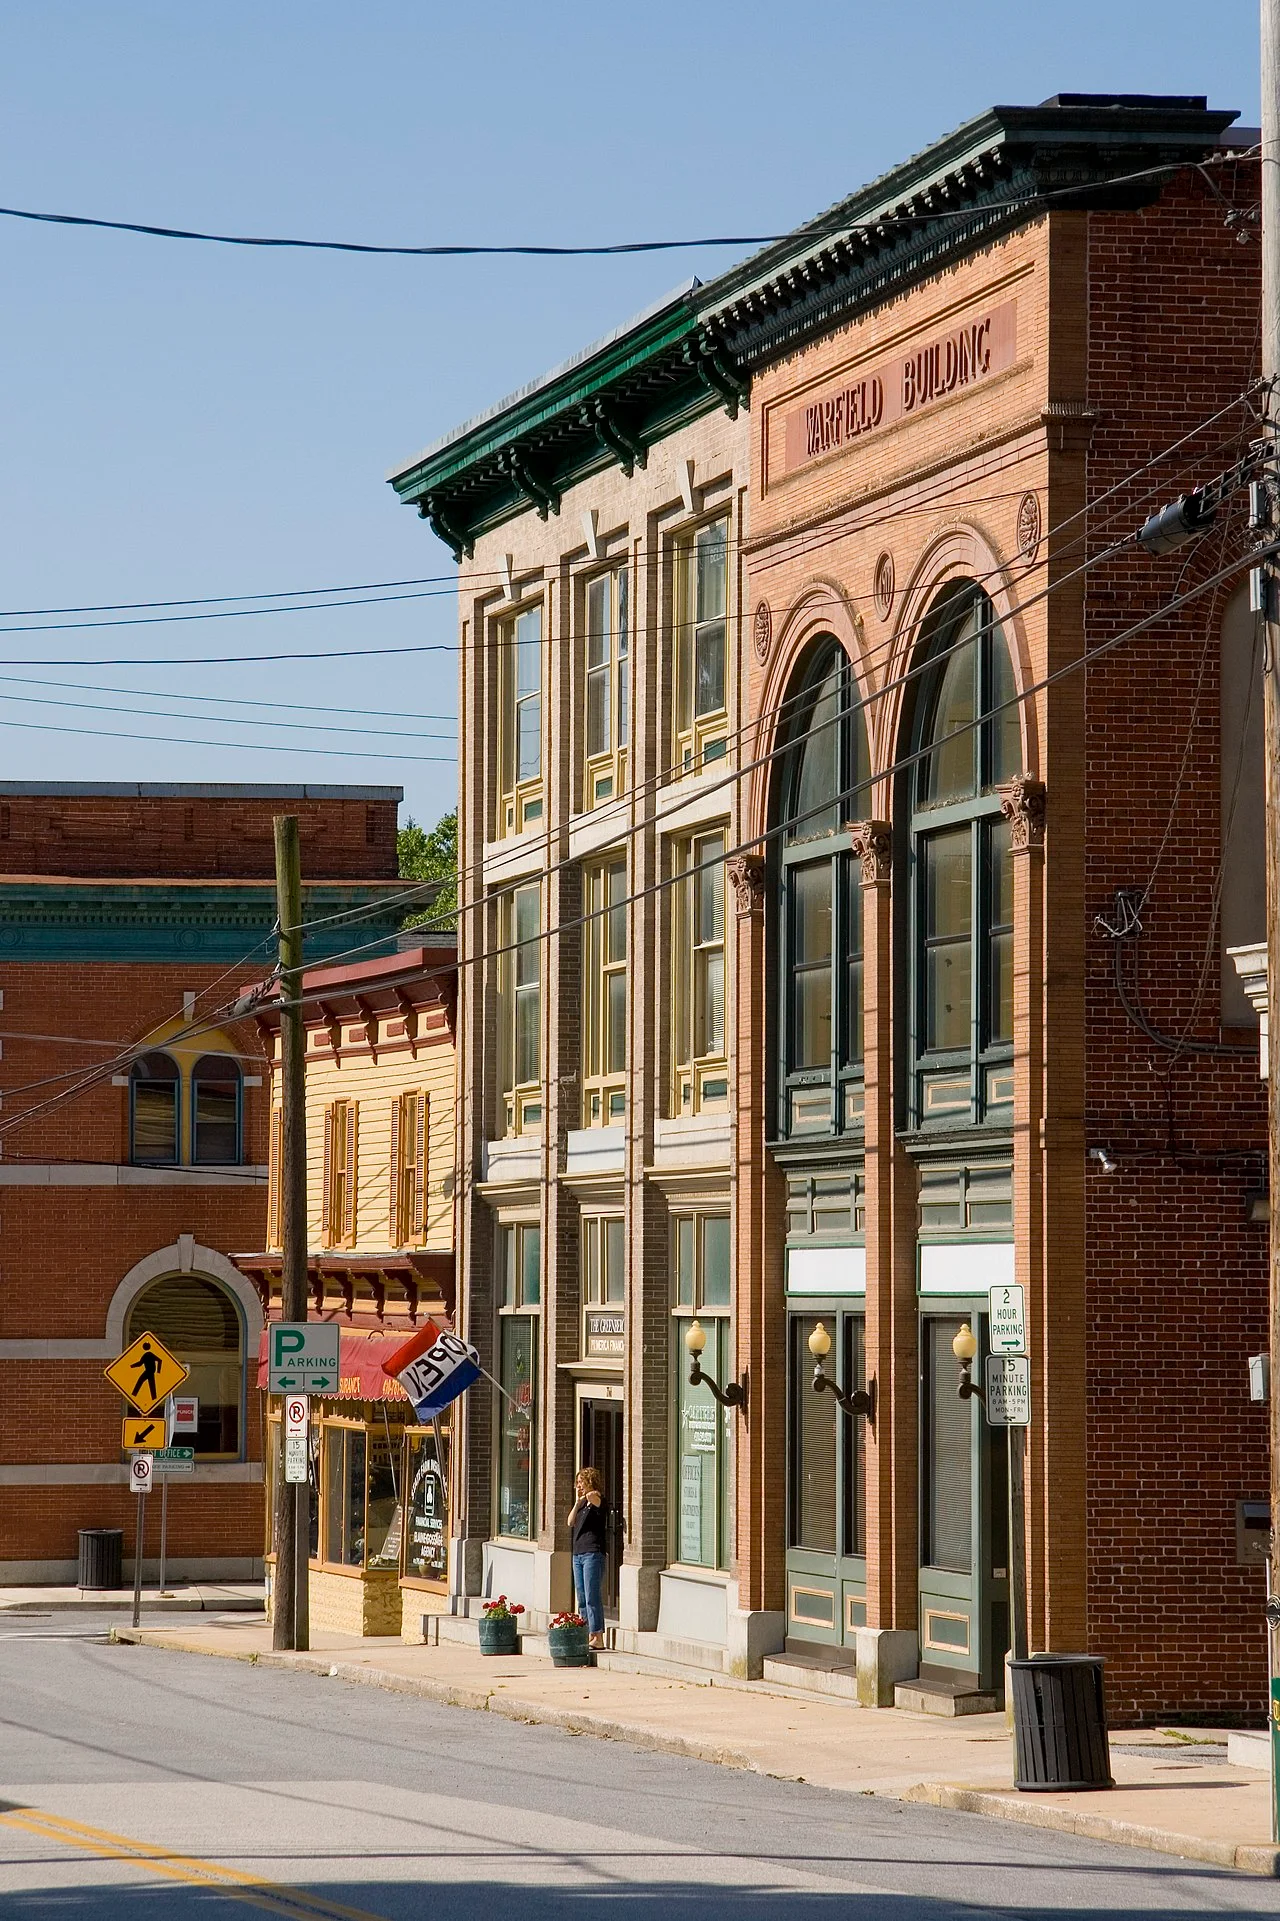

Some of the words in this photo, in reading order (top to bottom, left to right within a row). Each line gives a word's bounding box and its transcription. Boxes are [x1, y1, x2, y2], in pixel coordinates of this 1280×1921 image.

[903, 317, 991, 411] BUILDING
[1003, 1289, 1010, 1303] 2
[997, 1308, 1017, 1319] HOUR
[992, 1324, 1023, 1335] PARKING
[1001, 1359, 1016, 1371] 15
[992, 1374, 1025, 1383] MINUTE
[990, 1386, 1027, 1396] PARKING
[292, 1441, 301, 1449] 15
